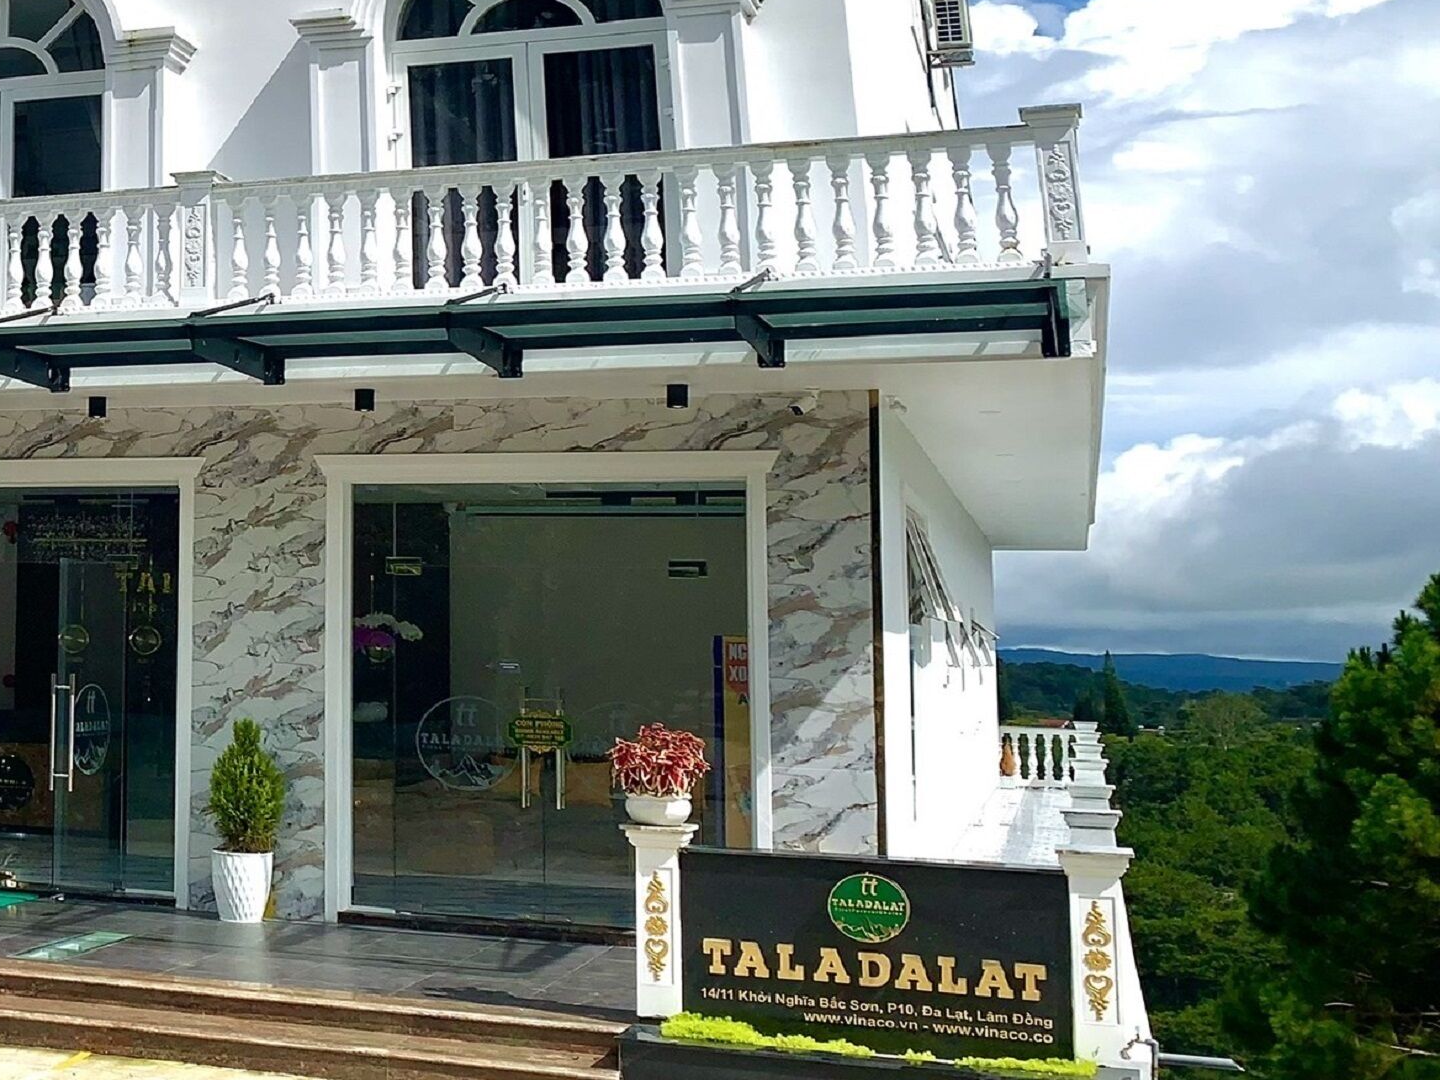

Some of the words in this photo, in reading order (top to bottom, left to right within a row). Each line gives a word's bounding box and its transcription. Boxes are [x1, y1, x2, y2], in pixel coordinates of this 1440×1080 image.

[831, 898, 905, 911] TALADALAT
[702, 937, 1047, 1002] TALADALAT
[701, 987, 734, 1000] 14/11
[738, 988, 772, 1003] Khởi
[819, 996, 846, 1010] Bắc
[850, 999, 884, 1014] Sơn,
[887, 1002, 918, 1017] P10,
[921, 1005, 942, 1018] Đa
[946, 1008, 973, 1022] Lạt,
[977, 1010, 1008, 1024] Lâm
[1012, 1012, 1053, 1029] Đồng
[803, 1011, 918, 1030] www.vinaco.vn
[932, 1023, 1053, 1044] www.vinaco.co
